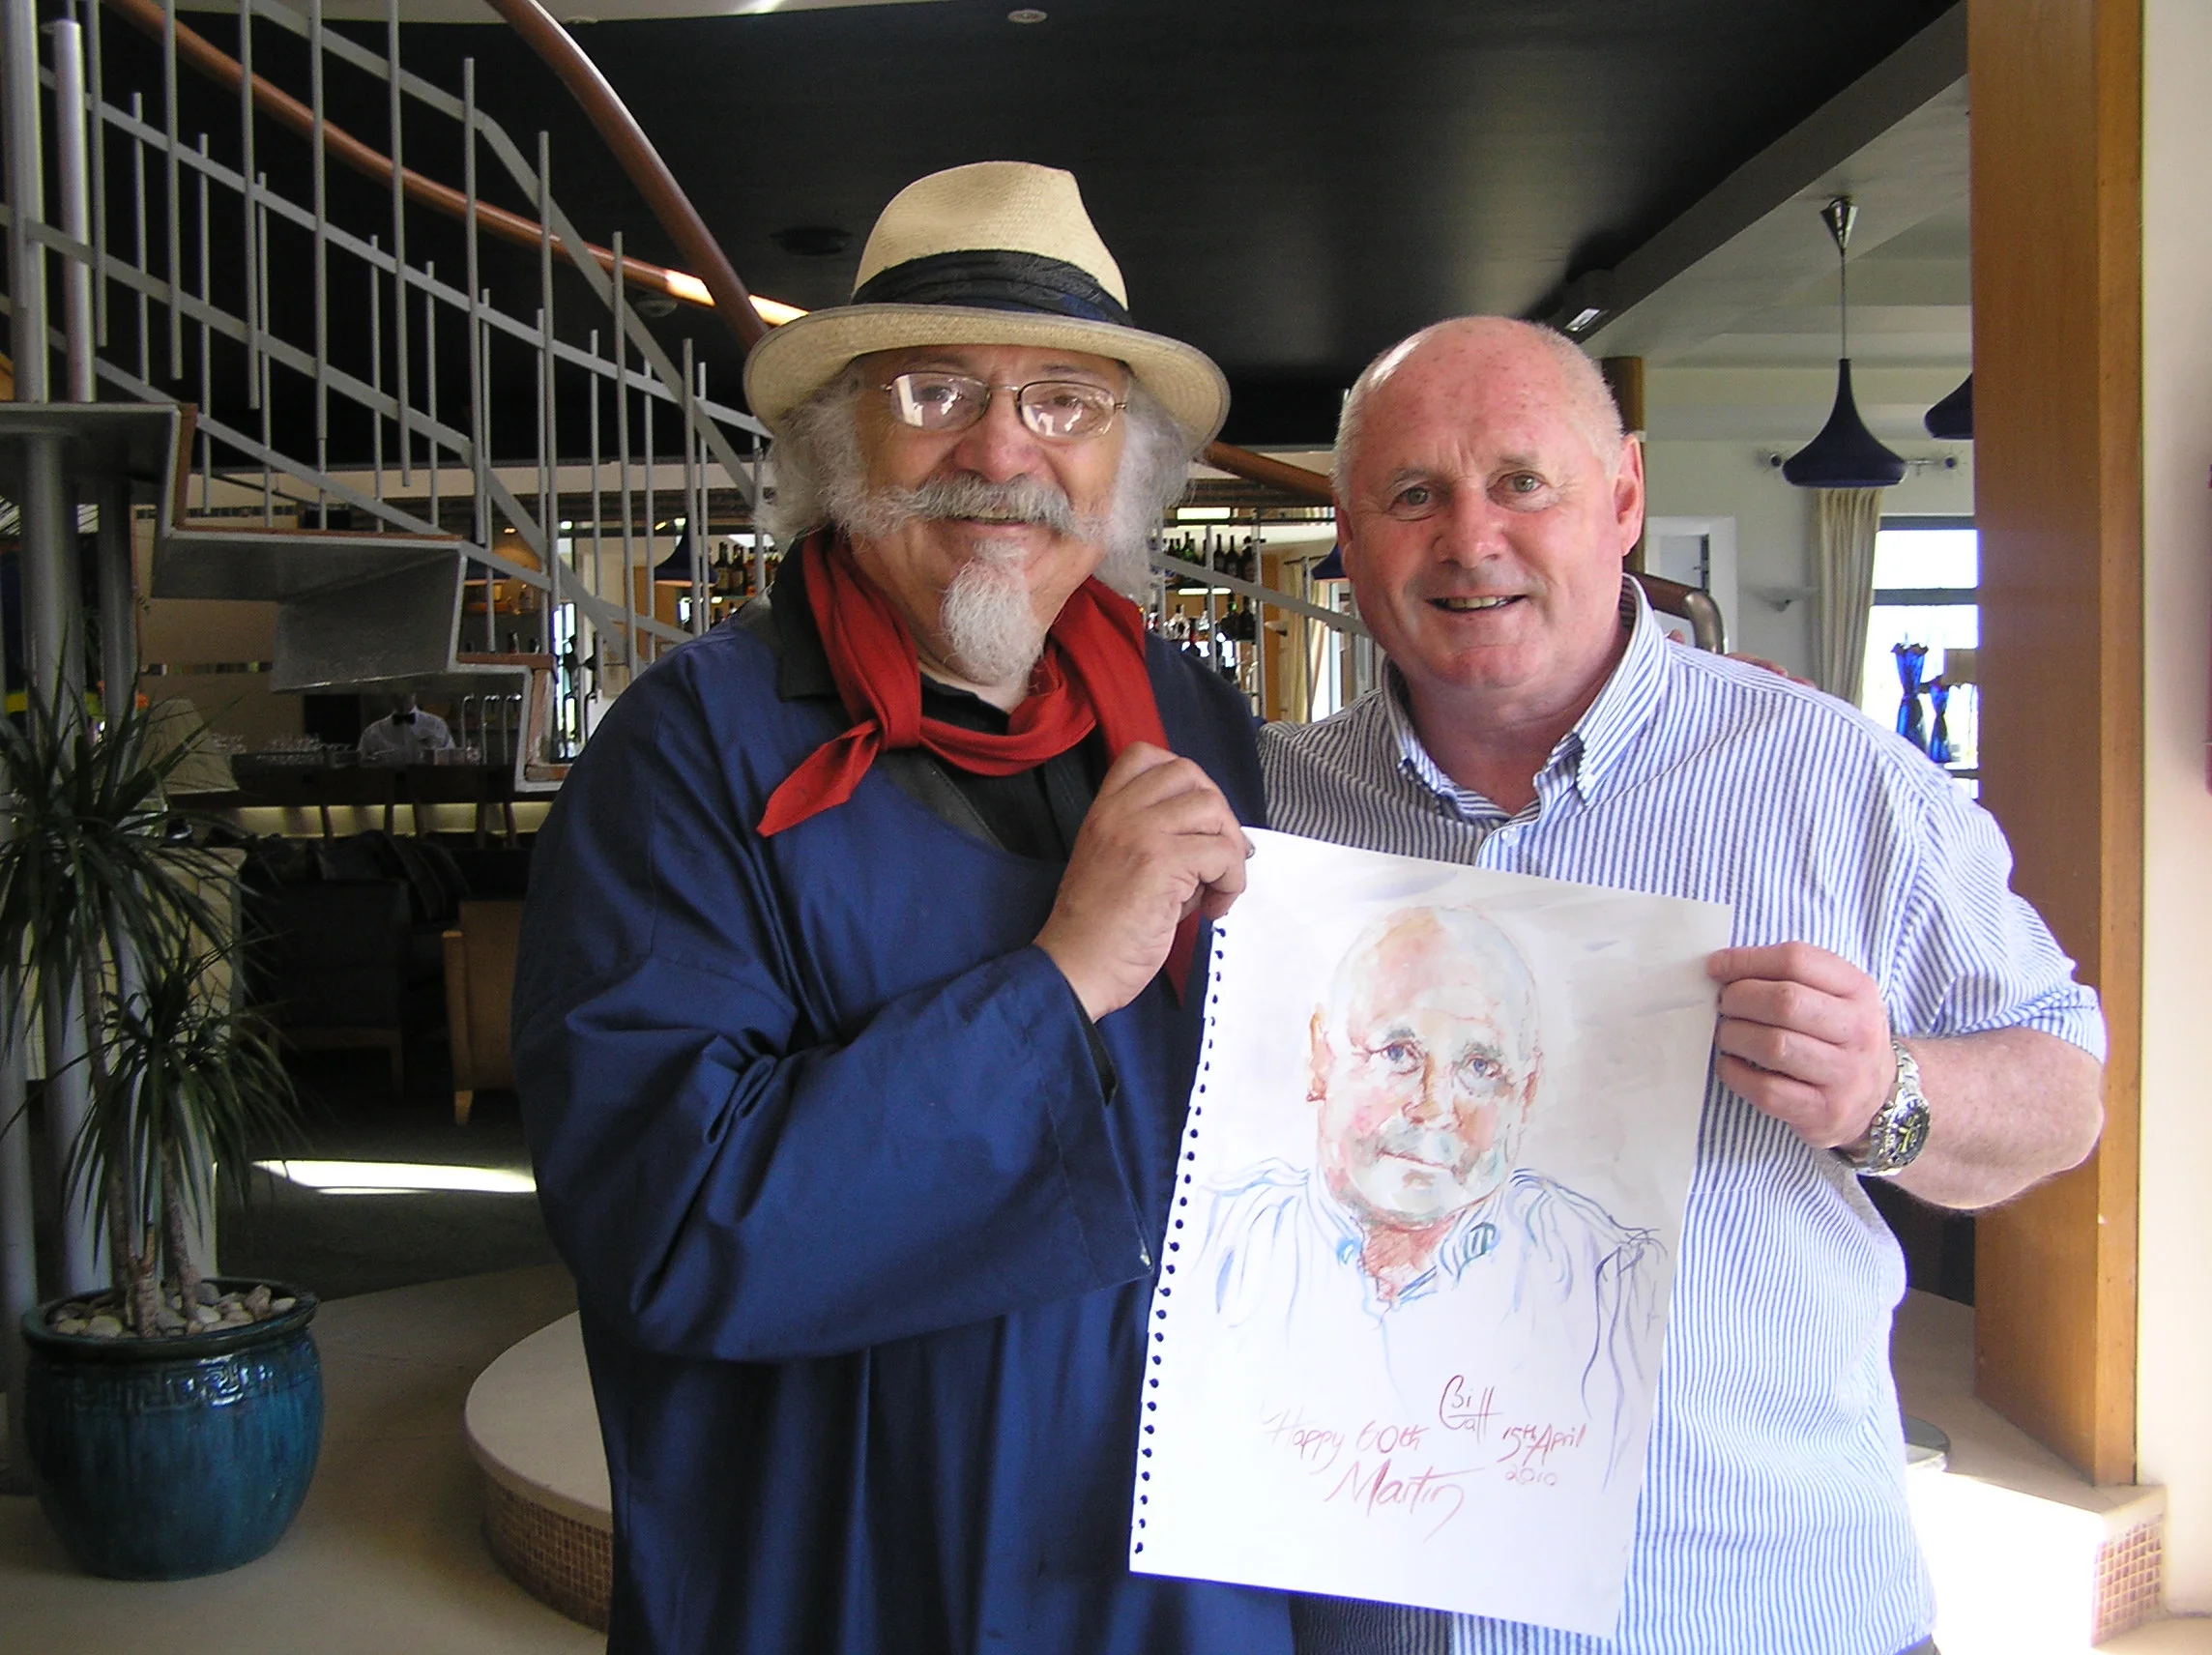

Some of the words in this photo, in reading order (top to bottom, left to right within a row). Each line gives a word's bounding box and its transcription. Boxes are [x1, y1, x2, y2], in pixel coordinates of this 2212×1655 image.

[1262, 1403, 1346, 1475] Happy
[1356, 1419, 1430, 1454] 60th
[1523, 1422, 1587, 1466] April
[1324, 1459, 1485, 1544] Martin
[1505, 1465, 1558, 1487] 2010
